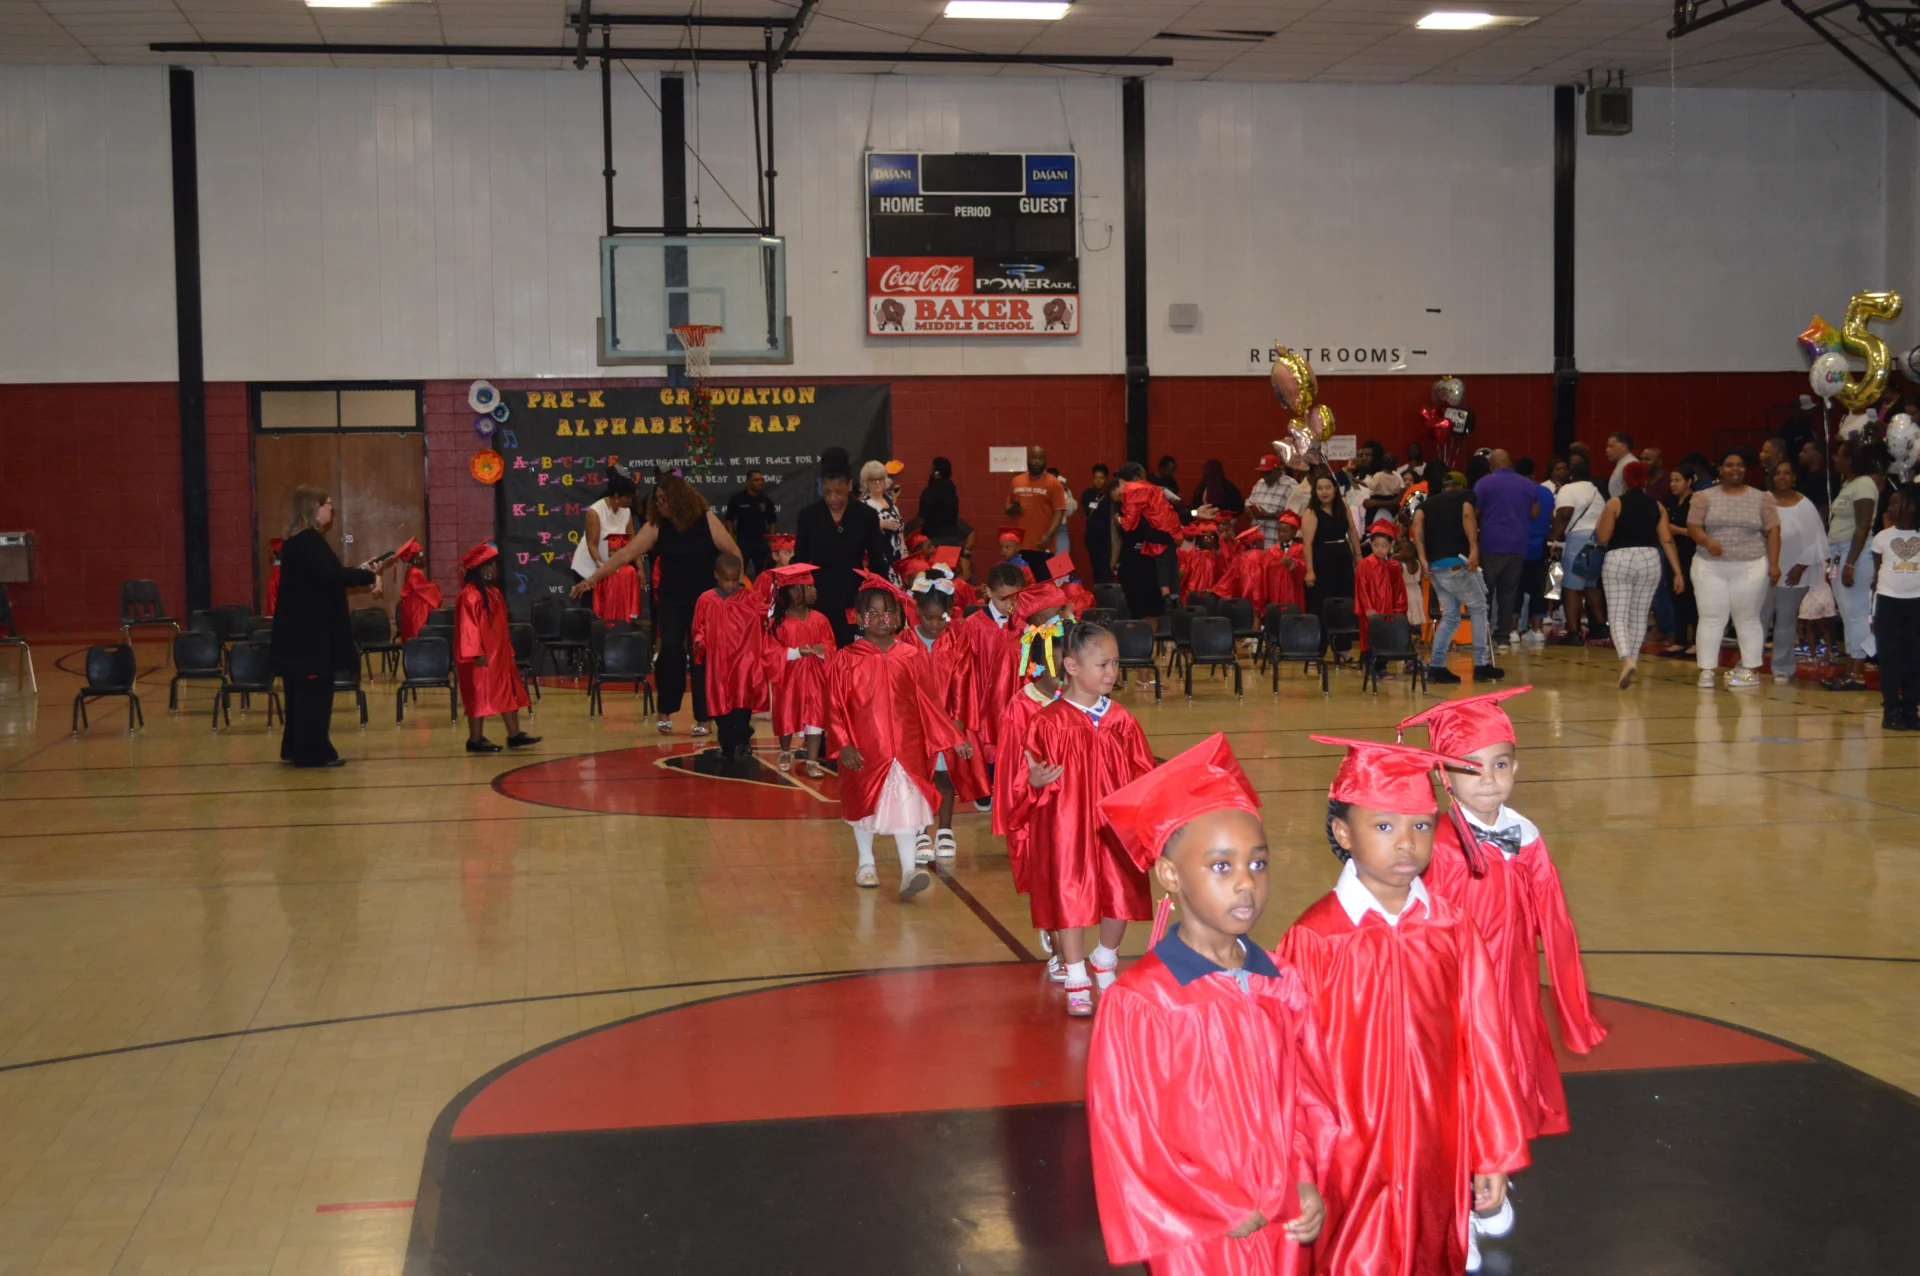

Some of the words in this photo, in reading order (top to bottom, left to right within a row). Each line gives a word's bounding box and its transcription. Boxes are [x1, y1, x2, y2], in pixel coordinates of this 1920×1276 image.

[875, 169, 912, 180] DASANI
[1032, 169, 1068, 180] DASANI
[880, 197, 924, 213] HOME
[954, 206, 991, 217] PERIOD
[1019, 197, 1068, 213] GUEST
[880, 264, 964, 293] Coca-Cola
[914, 299, 1033, 320] BAKER
[914, 321, 973, 331] MIDDLE
[977, 321, 1035, 330] SCHOOL
[526, 390, 605, 409] PRE-K
[660, 386, 816, 406] GRDUATION
[747, 415, 801, 433] RAP
[704, 458, 724, 466] WLL
[730, 457, 741, 466] BE
[744, 456, 761, 466] THE
[765, 456, 792, 465] PLACE
[795, 455, 812, 464] FOR
[705, 475, 728, 484] BEST
